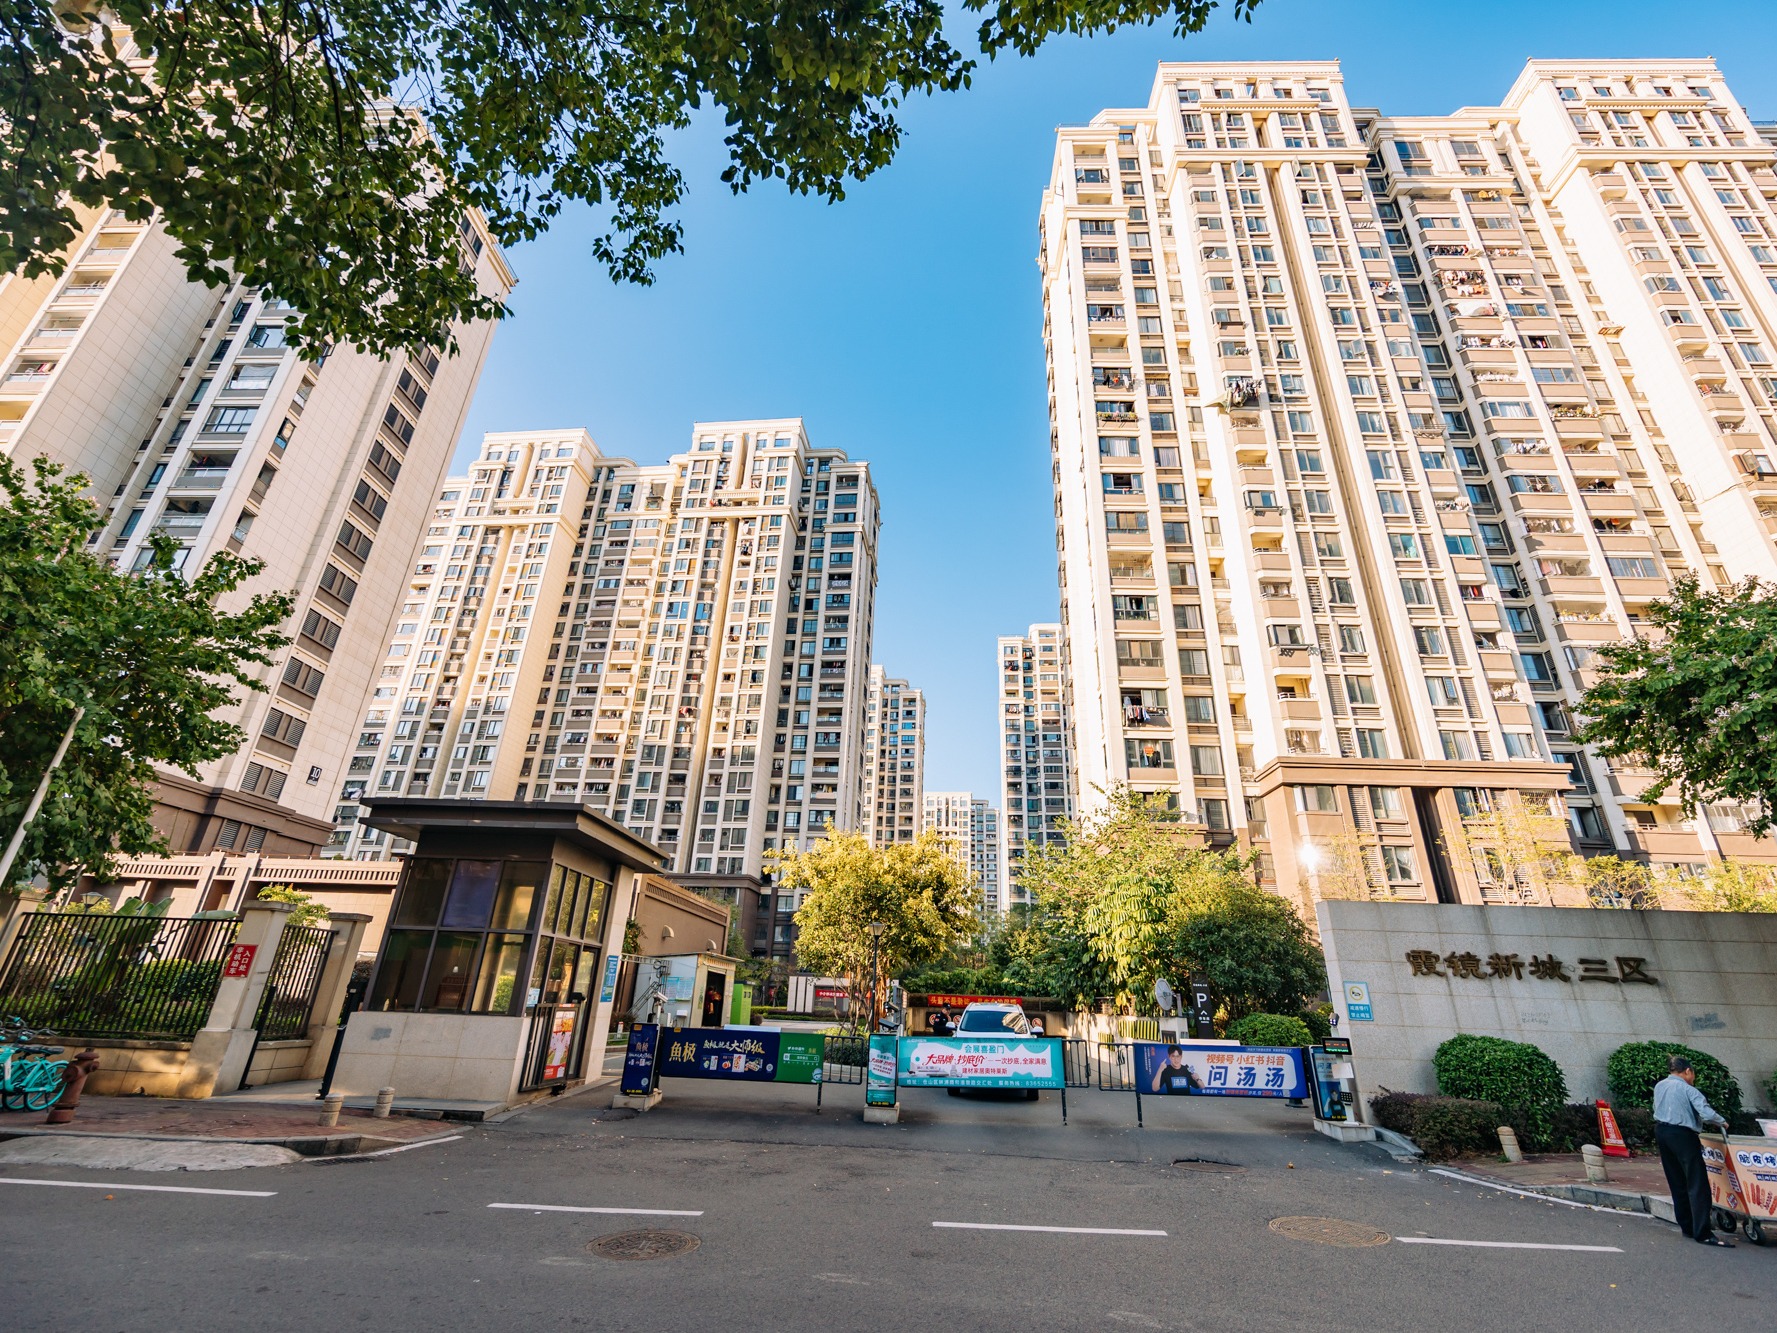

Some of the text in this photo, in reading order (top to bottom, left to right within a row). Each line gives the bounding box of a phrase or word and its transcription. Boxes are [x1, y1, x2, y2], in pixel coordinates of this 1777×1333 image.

[310, 767, 321, 778] 10
[229, 946, 244, 974] 非机动车
[238, 950, 250, 971] 入口处
[1404, 949, 1659, 985] 霞镜新城三区
[1196, 992, 1207, 1008] P
[965, 1044, 1004, 1054] 会展喜盈门
[1206, 1053, 1285, 1066] 视频号 小红书 抖音
[962, 1067, 1007, 1075] 建材家居奥特莱斯
[1207, 1065, 1285, 1087] 问汤汤
